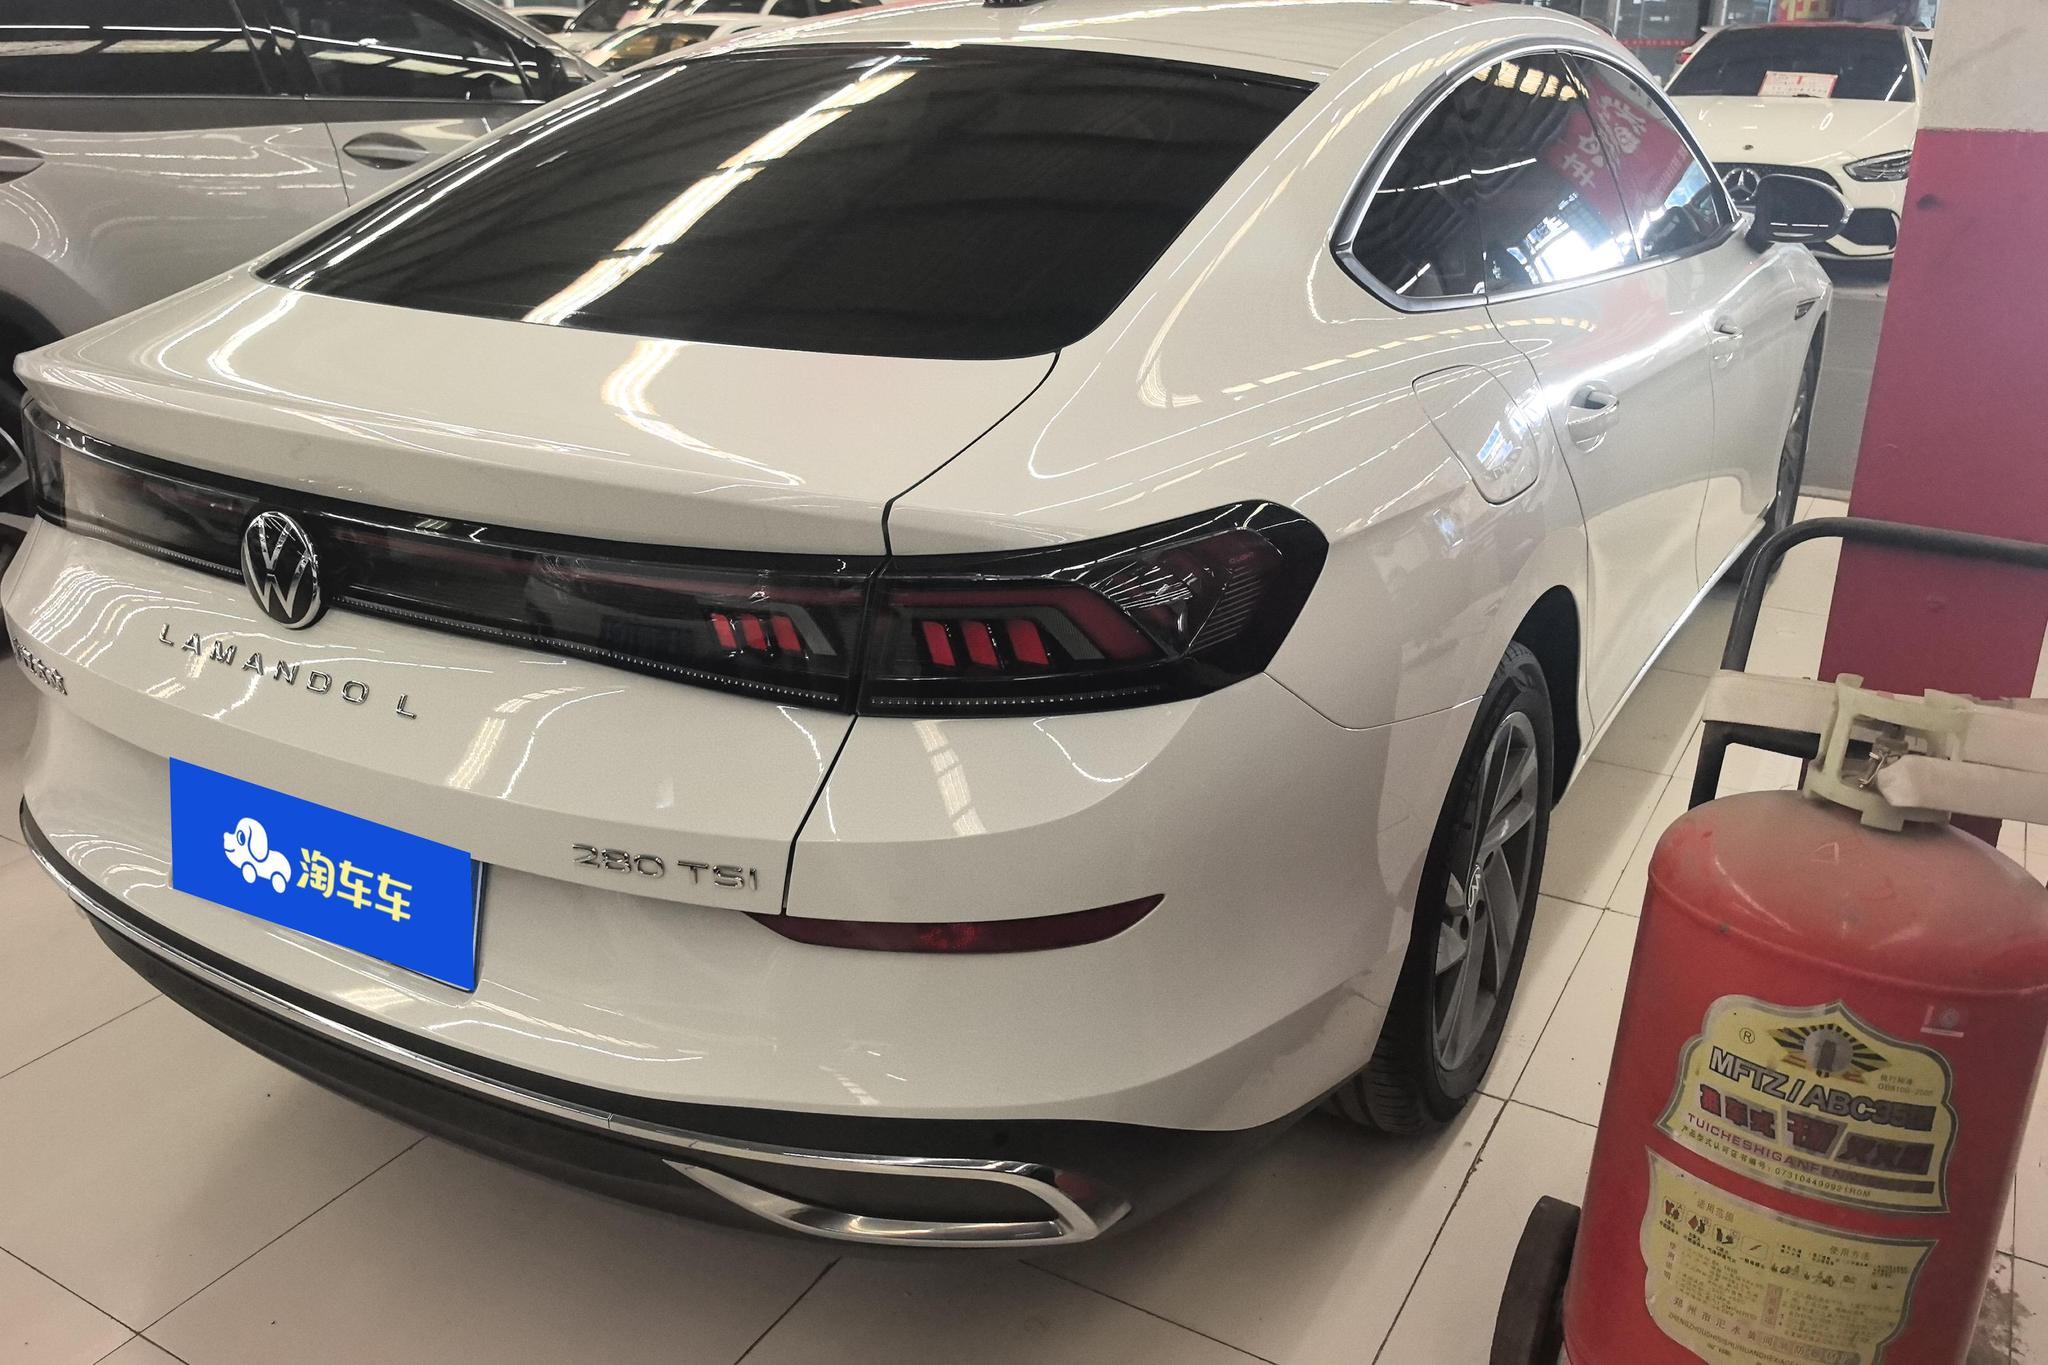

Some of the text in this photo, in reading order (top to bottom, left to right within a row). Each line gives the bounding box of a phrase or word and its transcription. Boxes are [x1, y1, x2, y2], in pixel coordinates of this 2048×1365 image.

[158, 622, 418, 720] LAMANDO L
[572, 842, 758, 891] 280 TSI
